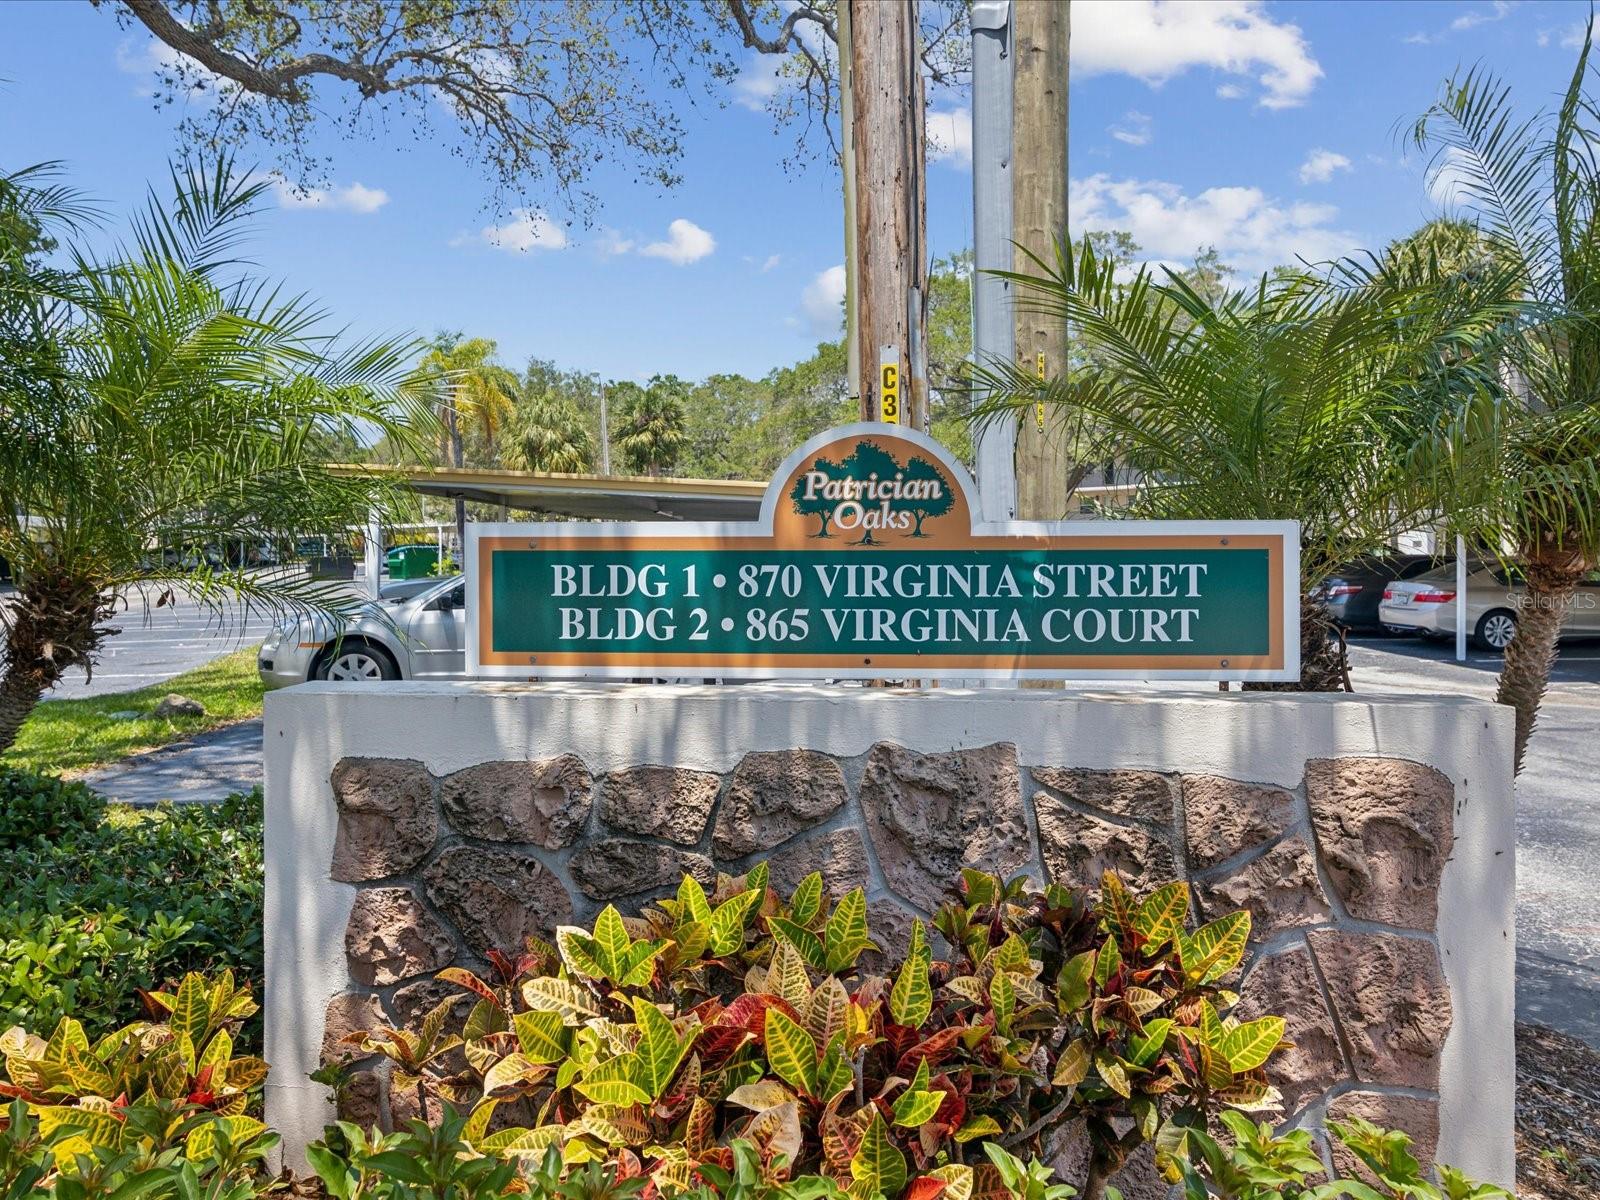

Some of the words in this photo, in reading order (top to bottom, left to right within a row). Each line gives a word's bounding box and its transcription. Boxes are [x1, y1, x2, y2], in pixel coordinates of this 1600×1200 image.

[882, 366, 898, 424] C3
[802, 471, 943, 501] Patrician
[832, 501, 911, 530] Oaks
[550, 564, 669, 597] BLDG
[682, 564, 700, 597] 1
[738, 564, 802, 597] 870
[812, 564, 1022, 597] VIRGINIA
[1032, 564, 1207, 597] STREET
[558, 607, 677, 641] BLDG
[688, 608, 709, 641] 2
[746, 608, 809, 641] 865
[820, 608, 1031, 642] VIRGINIA
[1041, 608, 1199, 642] COURT
